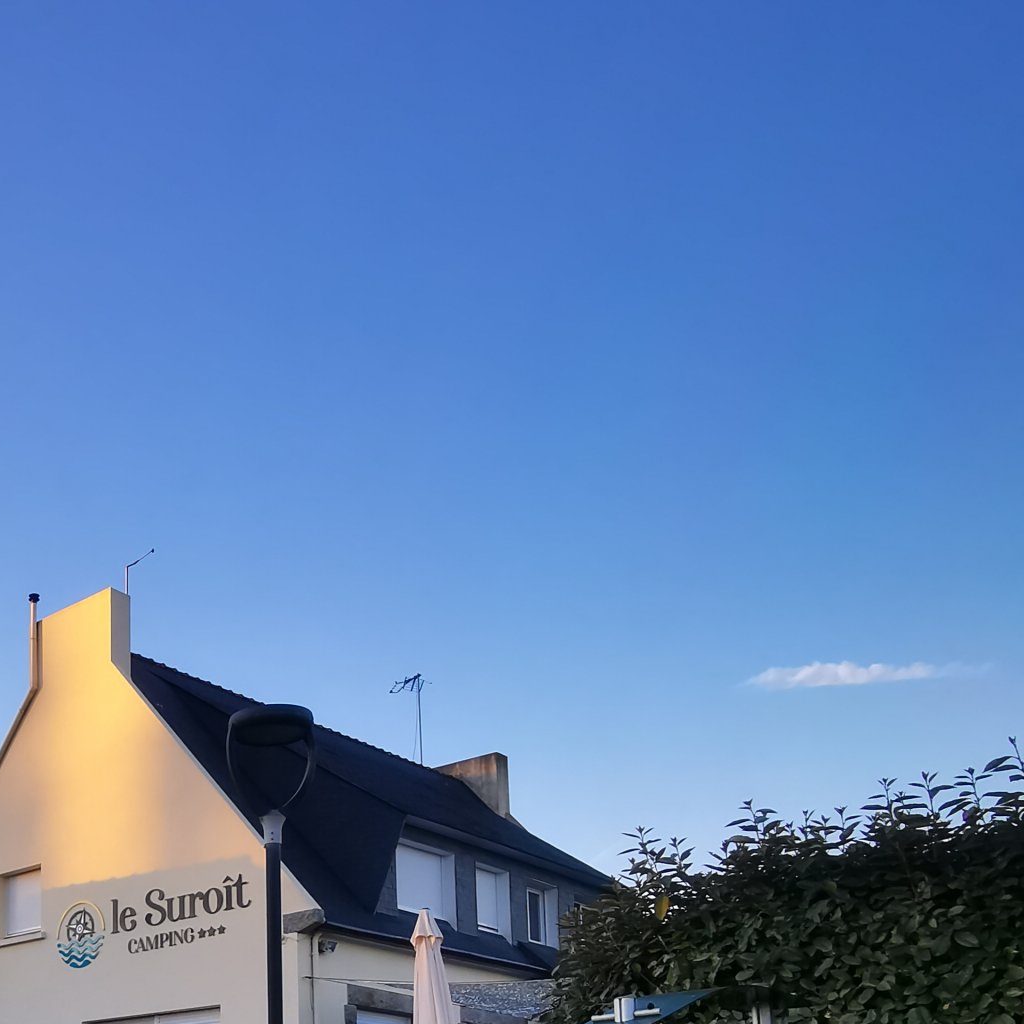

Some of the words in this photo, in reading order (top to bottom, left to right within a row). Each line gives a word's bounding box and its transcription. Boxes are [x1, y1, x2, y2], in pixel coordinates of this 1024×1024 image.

[110, 898, 137, 934] le
[144, 873, 252, 927] Suroît
[127, 927, 195, 954] CAMPING
